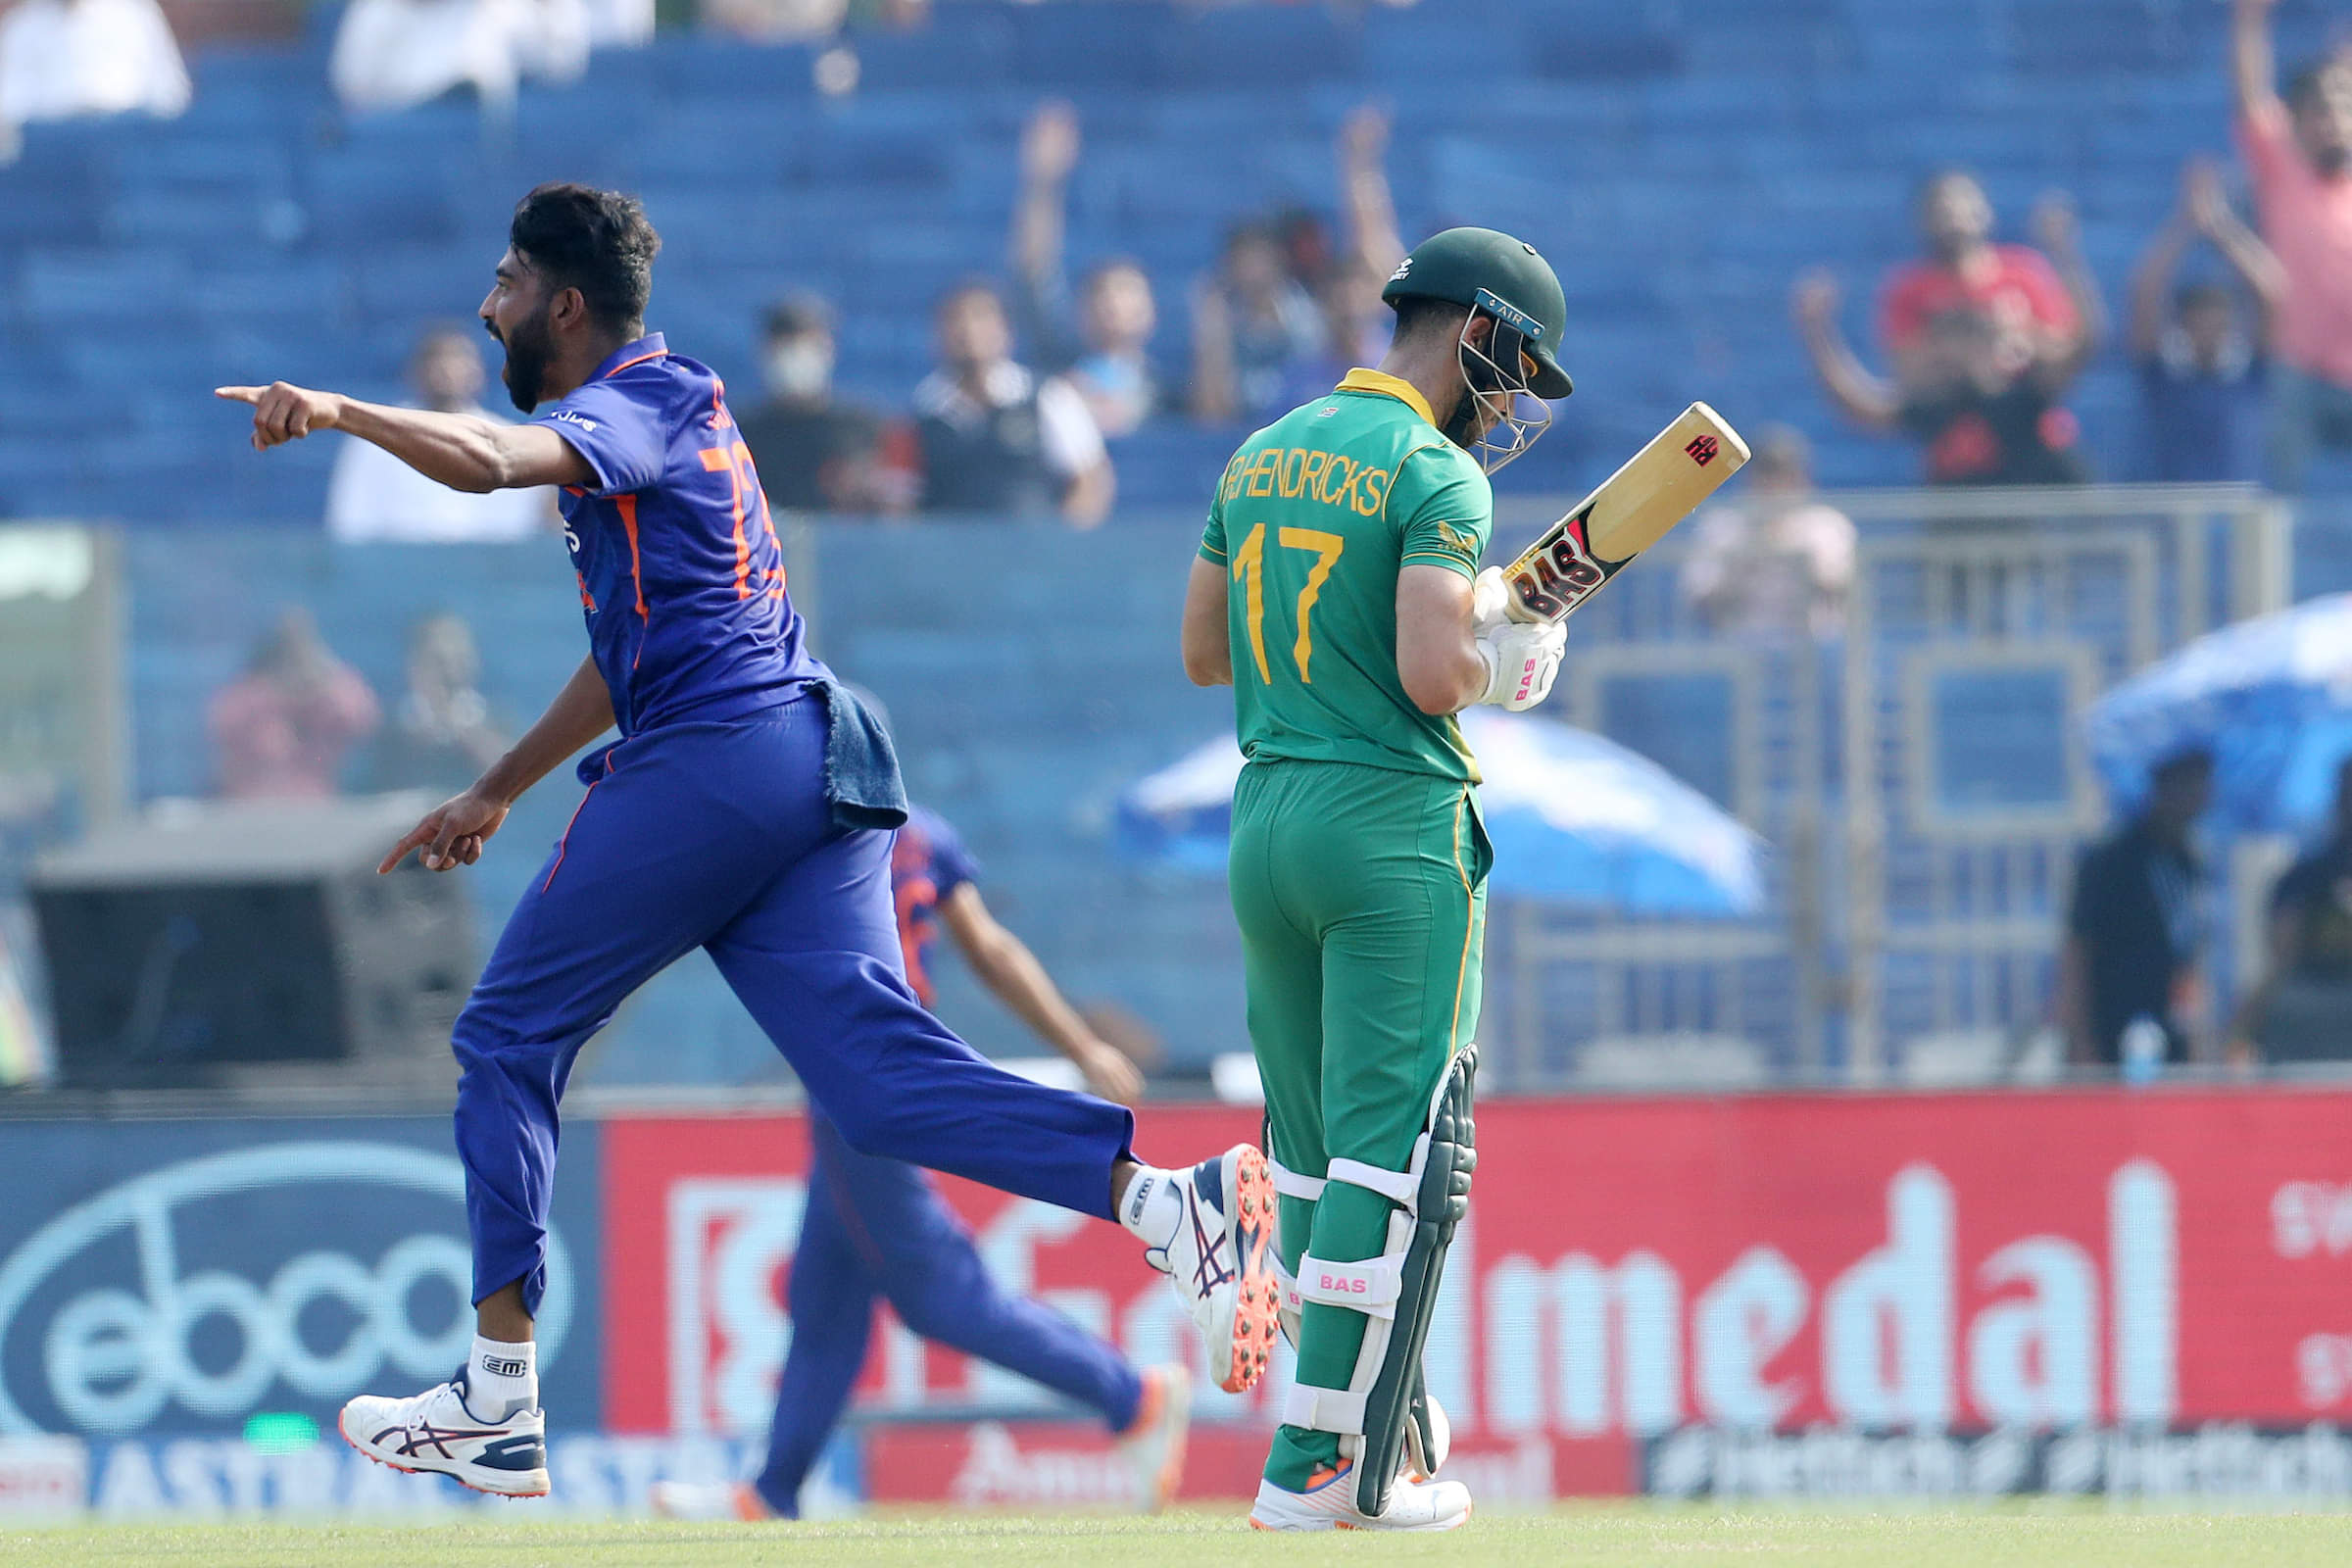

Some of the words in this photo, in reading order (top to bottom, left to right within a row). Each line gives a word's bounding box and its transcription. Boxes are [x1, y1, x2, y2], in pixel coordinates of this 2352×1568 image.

[1496, 305, 1524, 325] AIR
[1512, 540, 1602, 618] BAS
[1232, 522, 1345, 685] 17
[1514, 658, 1537, 702] BAS
[1319, 1274, 1367, 1294] BAS
